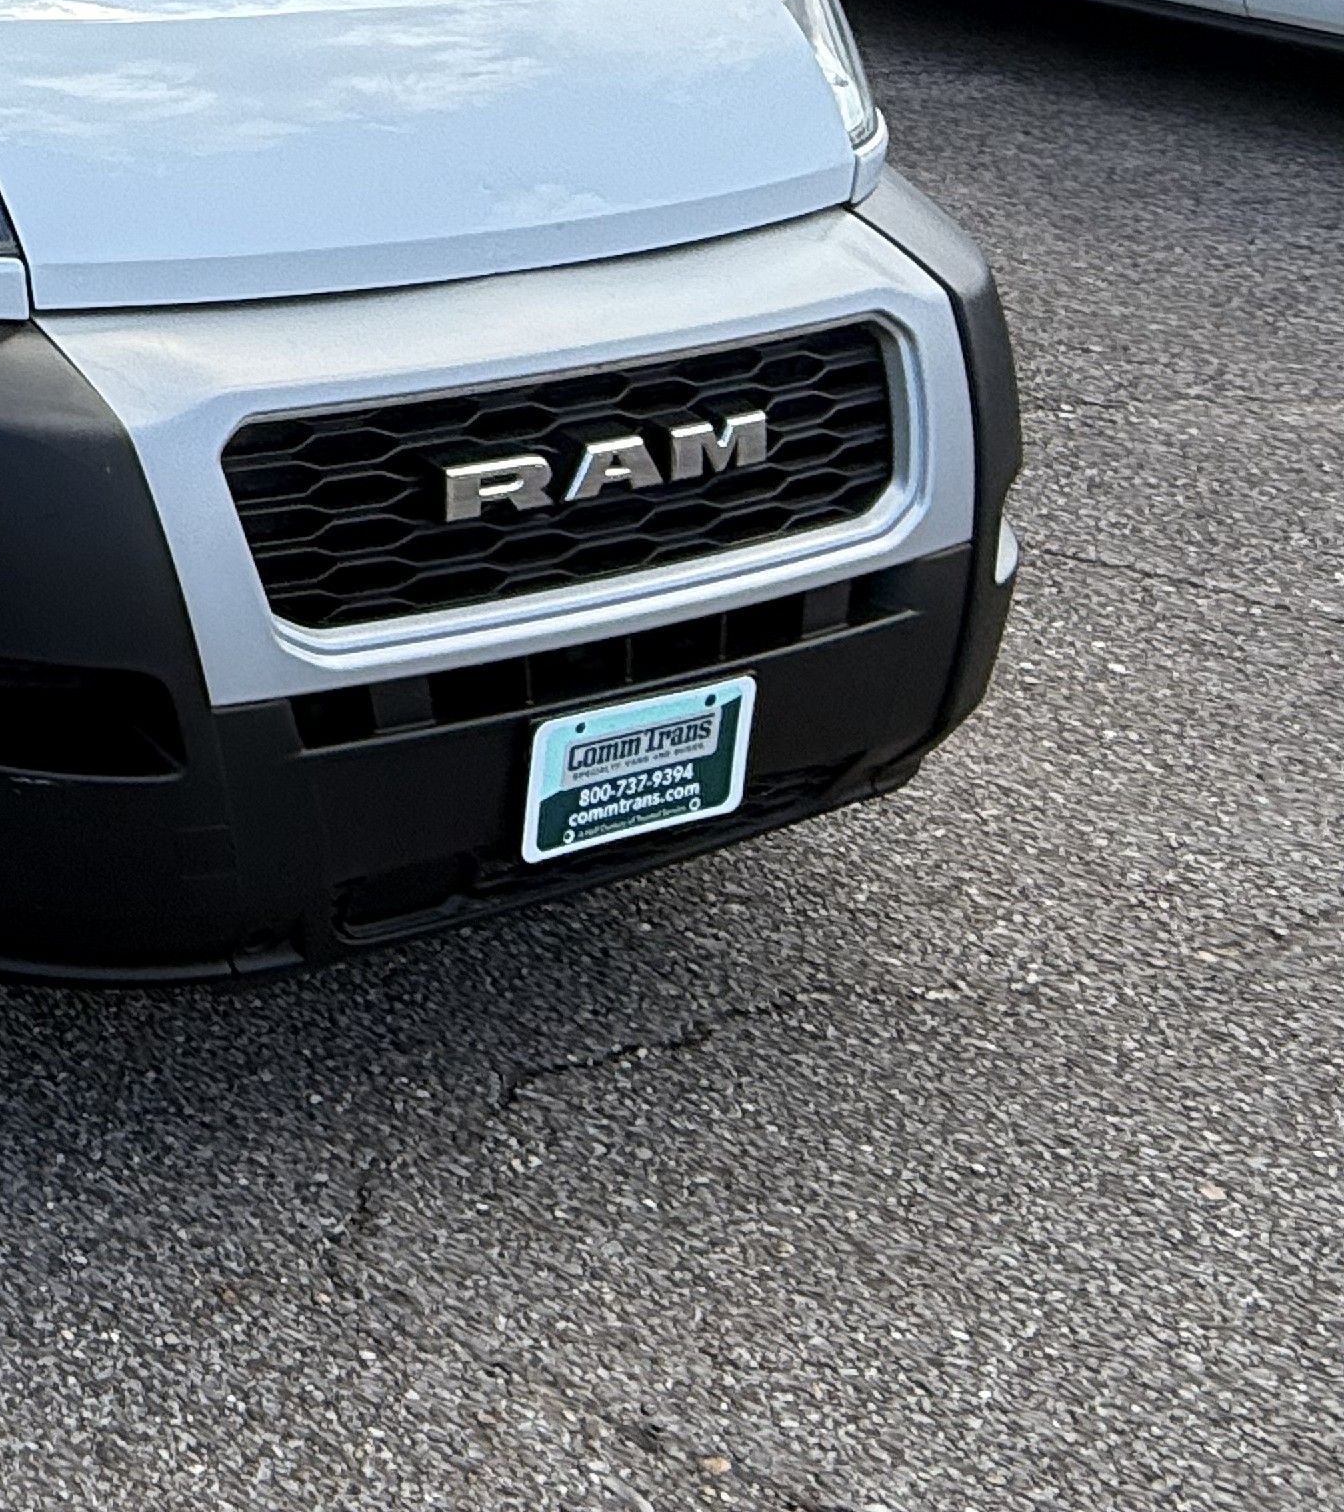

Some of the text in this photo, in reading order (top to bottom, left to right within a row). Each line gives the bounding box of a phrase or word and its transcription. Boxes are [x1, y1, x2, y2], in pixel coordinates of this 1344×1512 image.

[444, 410, 767, 522] RAM
[568, 716, 714, 771] Comm Trans
[568, 783, 700, 827] commtrans.com
[578, 763, 694, 807] 800-737-9394
